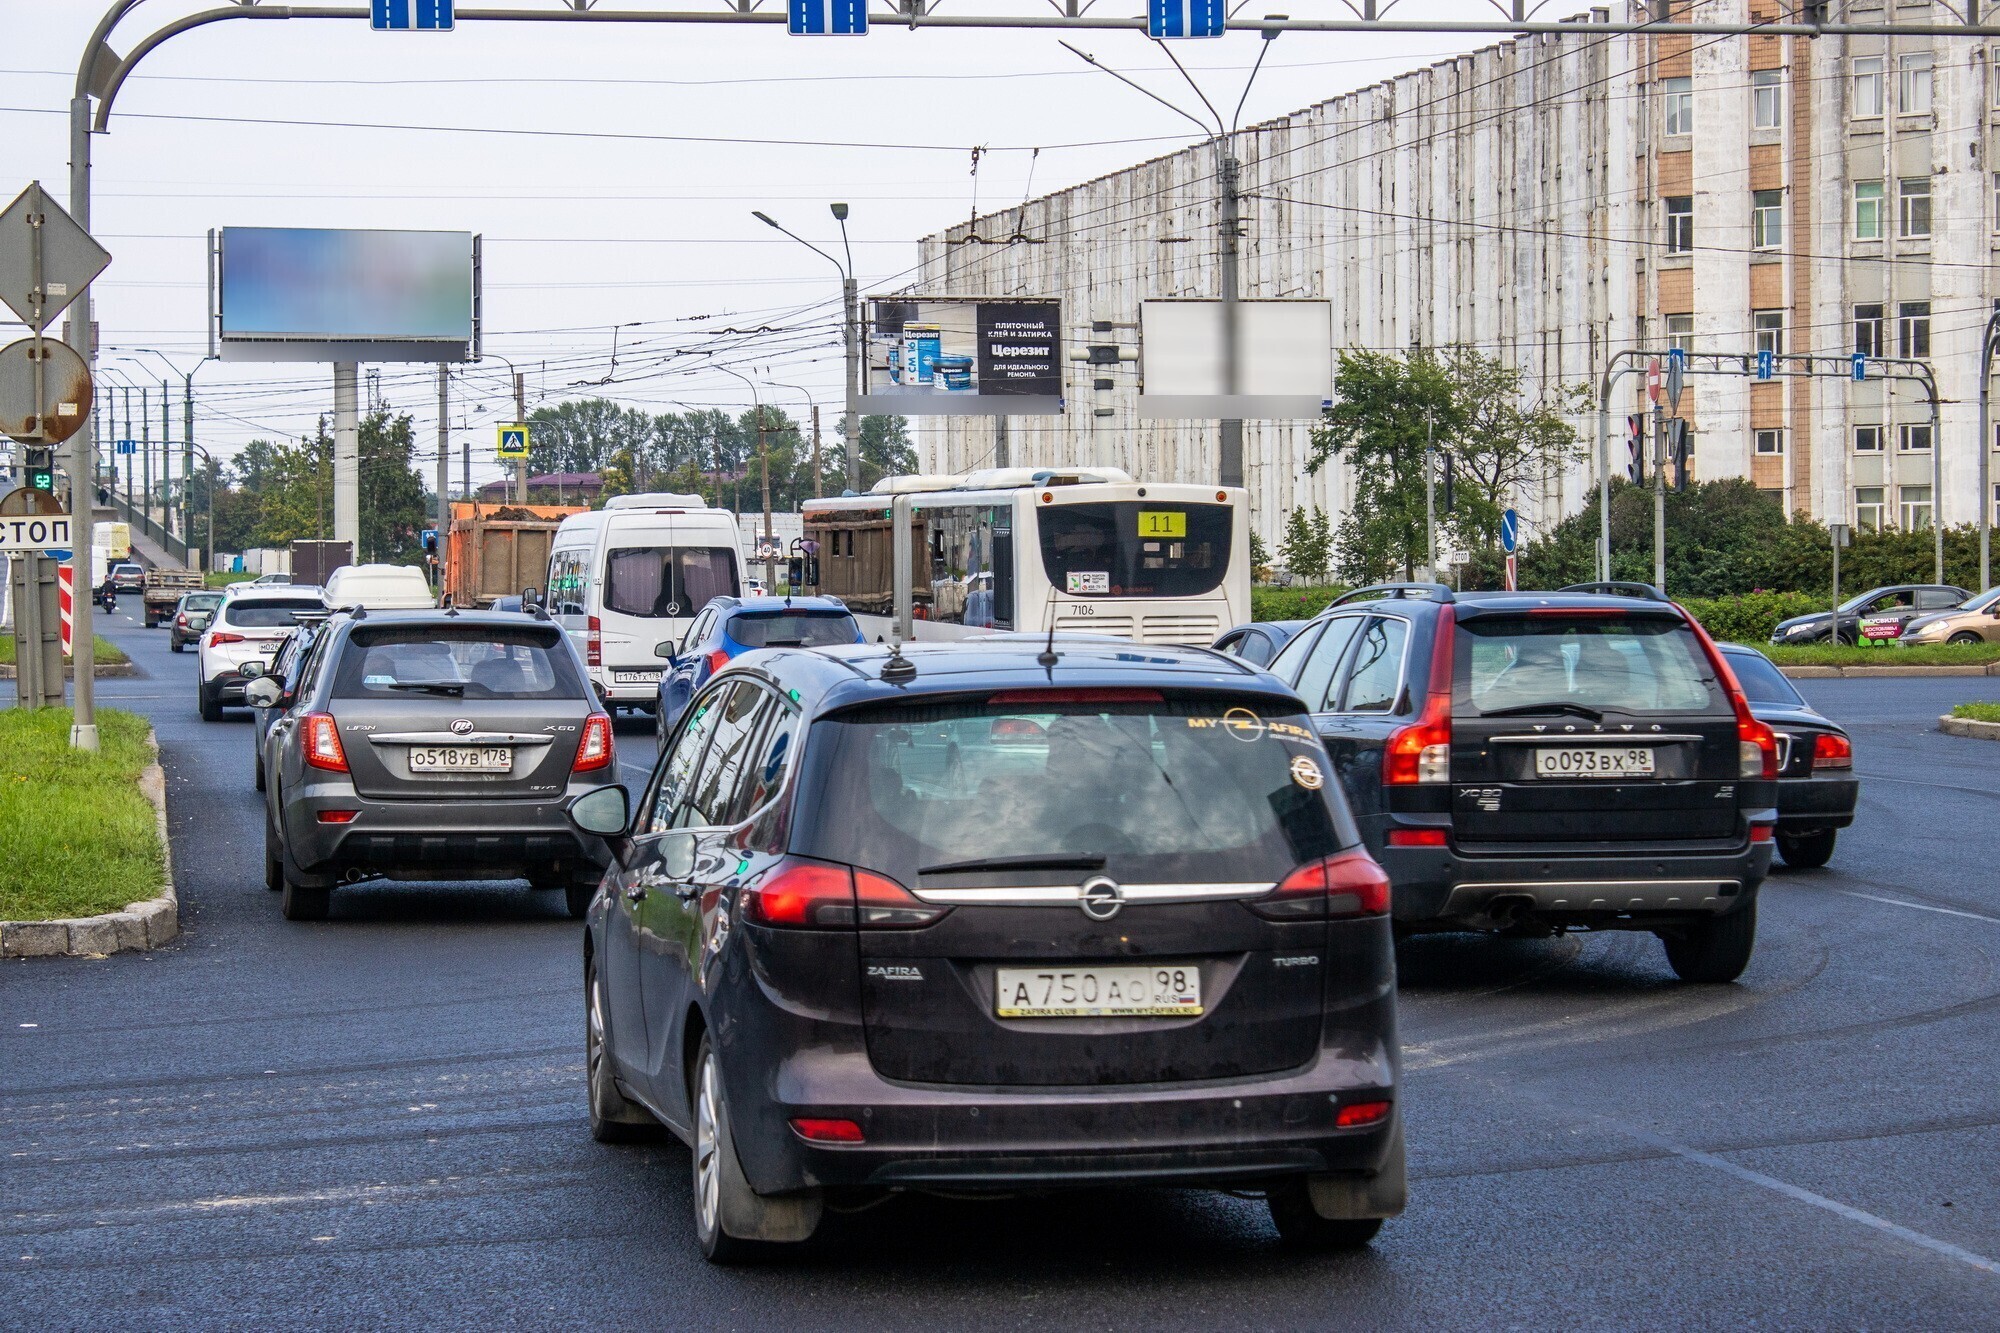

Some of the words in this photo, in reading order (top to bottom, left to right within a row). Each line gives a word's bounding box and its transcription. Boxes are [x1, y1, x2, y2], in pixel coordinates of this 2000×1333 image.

[991, 344, 1050, 357] Церезит
[36, 474, 50, 488] 52
[1150, 515, 1173, 533] 11
[1454, 552, 1467, 561] СТОП
[1071, 605, 1094, 616] 7106
[1187, 718, 1218, 728] MY
[1533, 724, 1662, 732] VOLVO
[415, 749, 479, 765] О518УВ
[1545, 751, 1624, 770] О093ВХ
[1459, 788, 1502, 798] XC90
[1272, 956, 1319, 967] TURBO
[867, 966, 921, 975] ZAFIRA
[1154, 995, 1177, 1004] RUS
[1020, 1008, 1050, 1016] ZAFIRA
